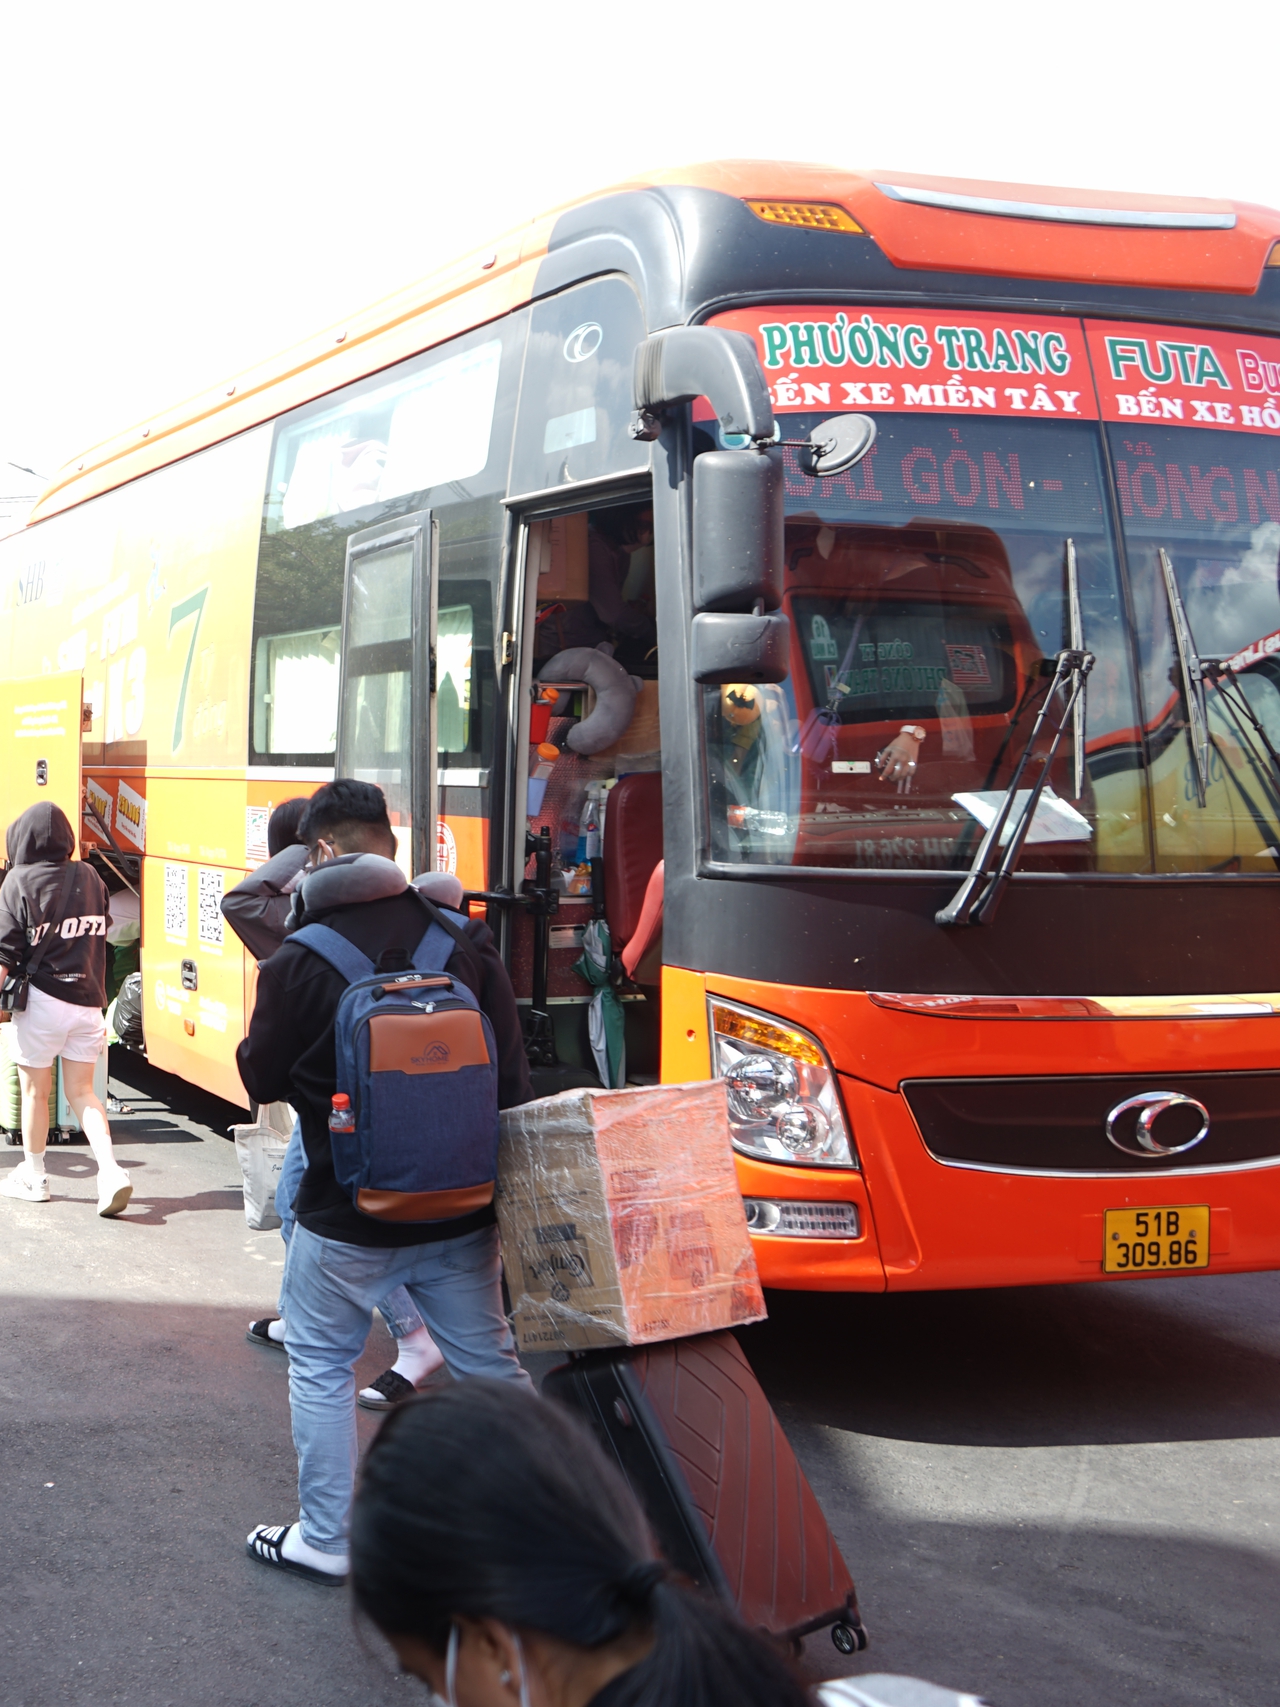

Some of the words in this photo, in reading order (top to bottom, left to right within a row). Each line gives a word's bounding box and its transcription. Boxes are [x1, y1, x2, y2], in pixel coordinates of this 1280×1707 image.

[760, 312, 932, 369] PHƯƠNG
[936, 325, 1071, 375] TRANG
[1104, 336, 1233, 390] FUTA
[1236, 349, 1280, 396] Bu
[769, 372, 831, 407] ẾN
[840, 382, 895, 405] XE
[901, 374, 996, 408] MIỀN
[1004, 383, 1081, 412] TÂY
[1115, 387, 1184, 420] BẾN
[1190, 400, 1236, 425] XE
[901, 428, 1024, 510] GÒN
[168, 585, 209, 752] 7
[1135, 1210, 1180, 1237] 51B
[1116, 1239, 1198, 1269] 309.86
